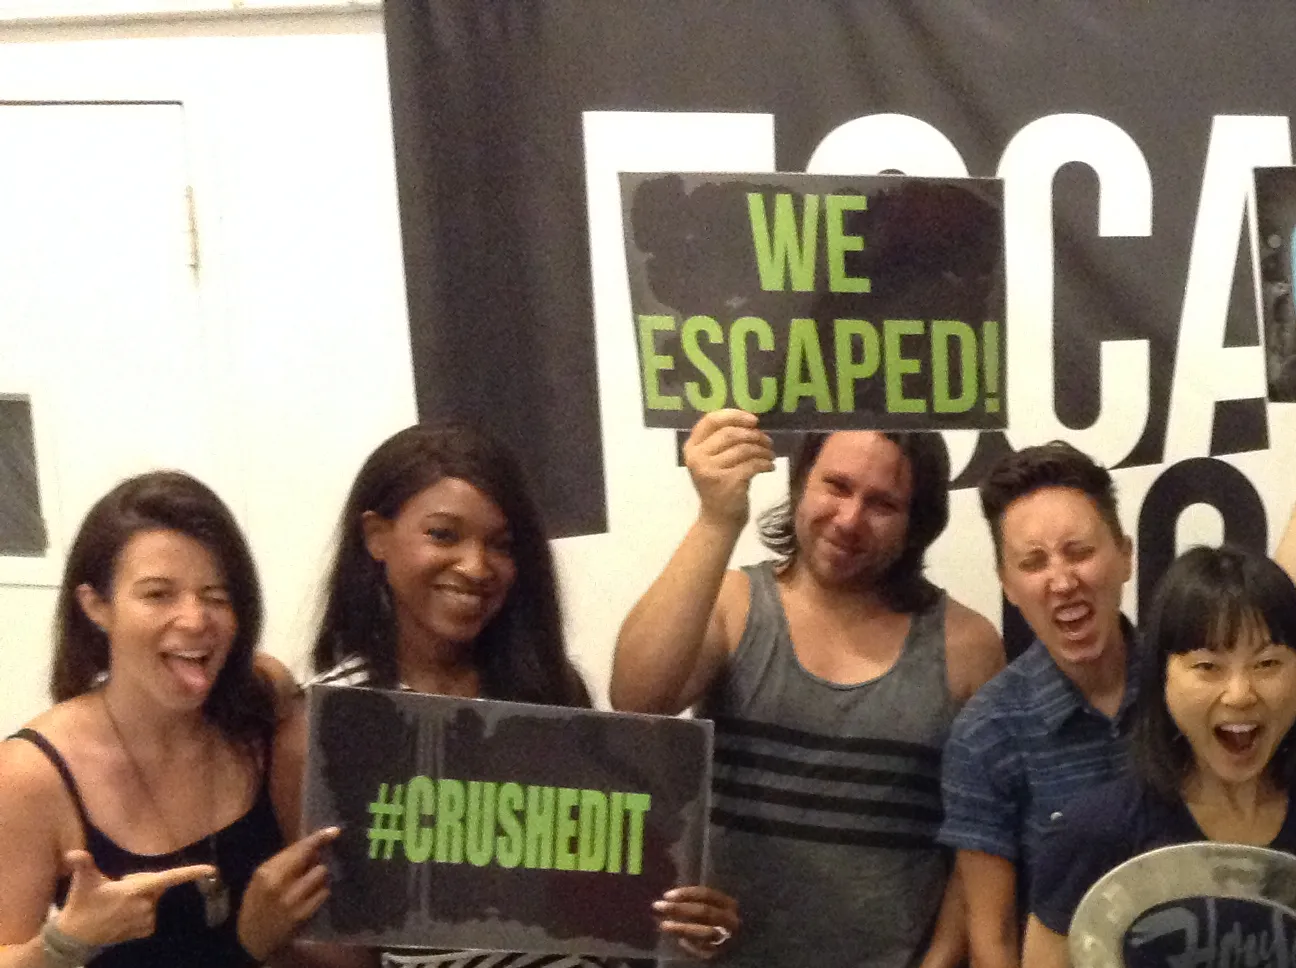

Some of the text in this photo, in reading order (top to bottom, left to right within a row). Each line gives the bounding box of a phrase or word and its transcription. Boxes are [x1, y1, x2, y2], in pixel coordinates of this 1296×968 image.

[747, 193, 871, 293] WE
[638, 315, 999, 413] ESCAPED!
[367, 775, 651, 875] #CRUSHEDIT
